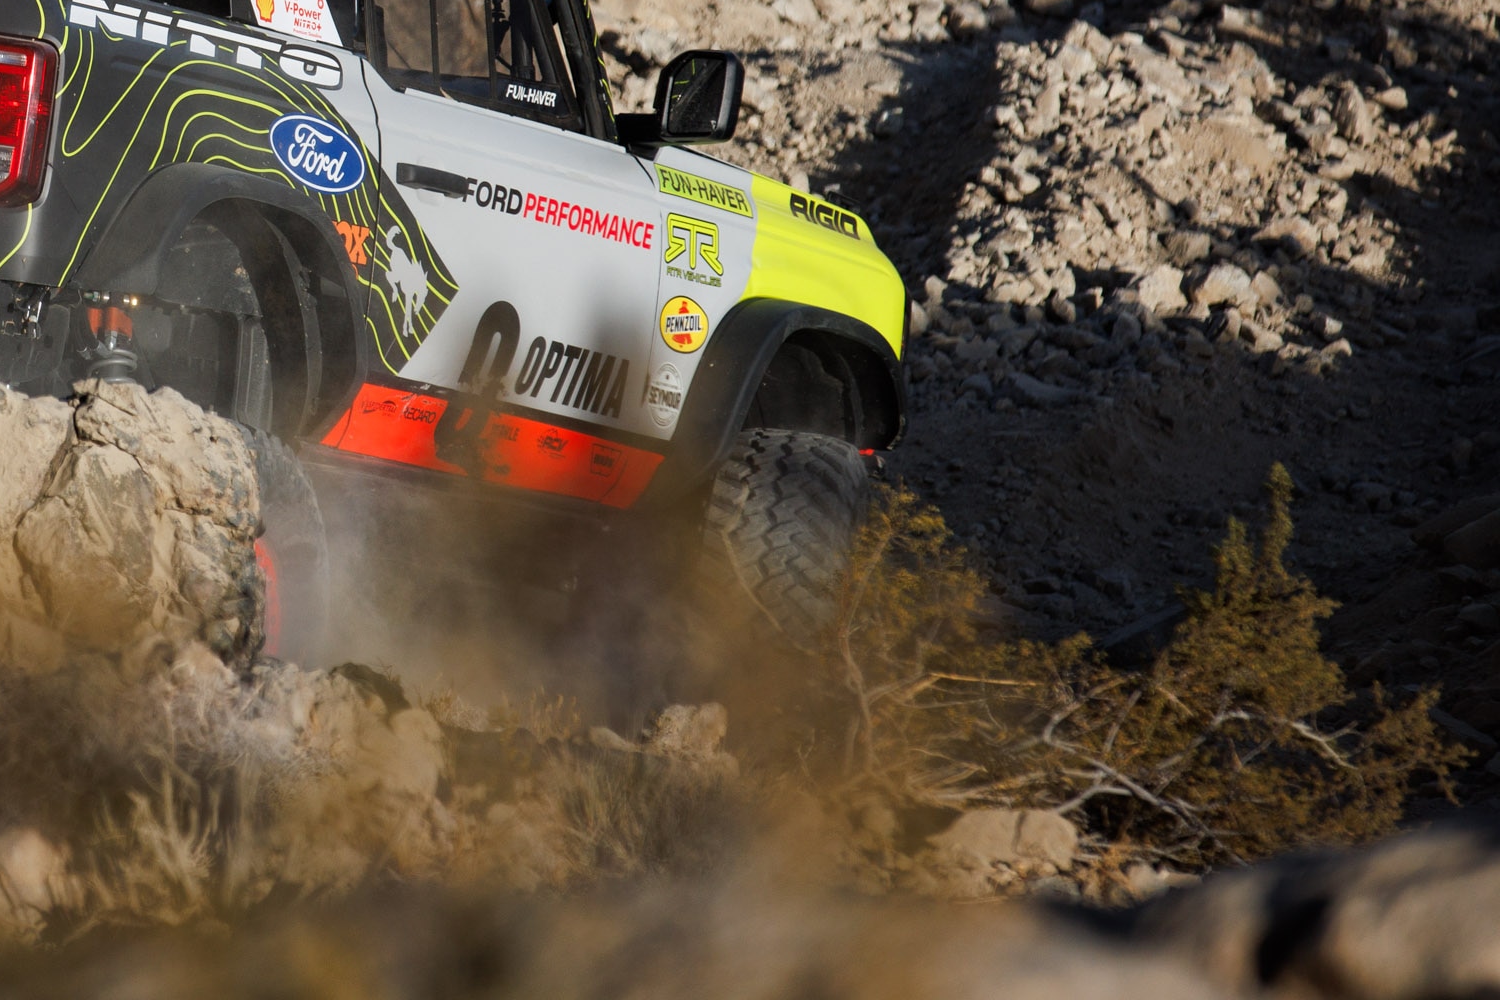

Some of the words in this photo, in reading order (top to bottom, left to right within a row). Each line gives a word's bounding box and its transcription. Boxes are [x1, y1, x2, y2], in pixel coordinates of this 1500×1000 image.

[284, 0, 321, 20] V-Power
[506, 84, 556, 107] FUN-HAVER
[288, 124, 347, 183] Ford
[660, 168, 748, 212] FUN-HAVER
[790, 192, 861, 240] RIGID
[666, 265, 683, 279] RTR
[683, 270, 722, 287] VEHICLES
[665, 315, 702, 333] PENNZOIL
[514, 336, 630, 419] OPTIMA
[649, 386, 681, 409] SEYMOUR
[404, 406, 436, 424] RECARO
